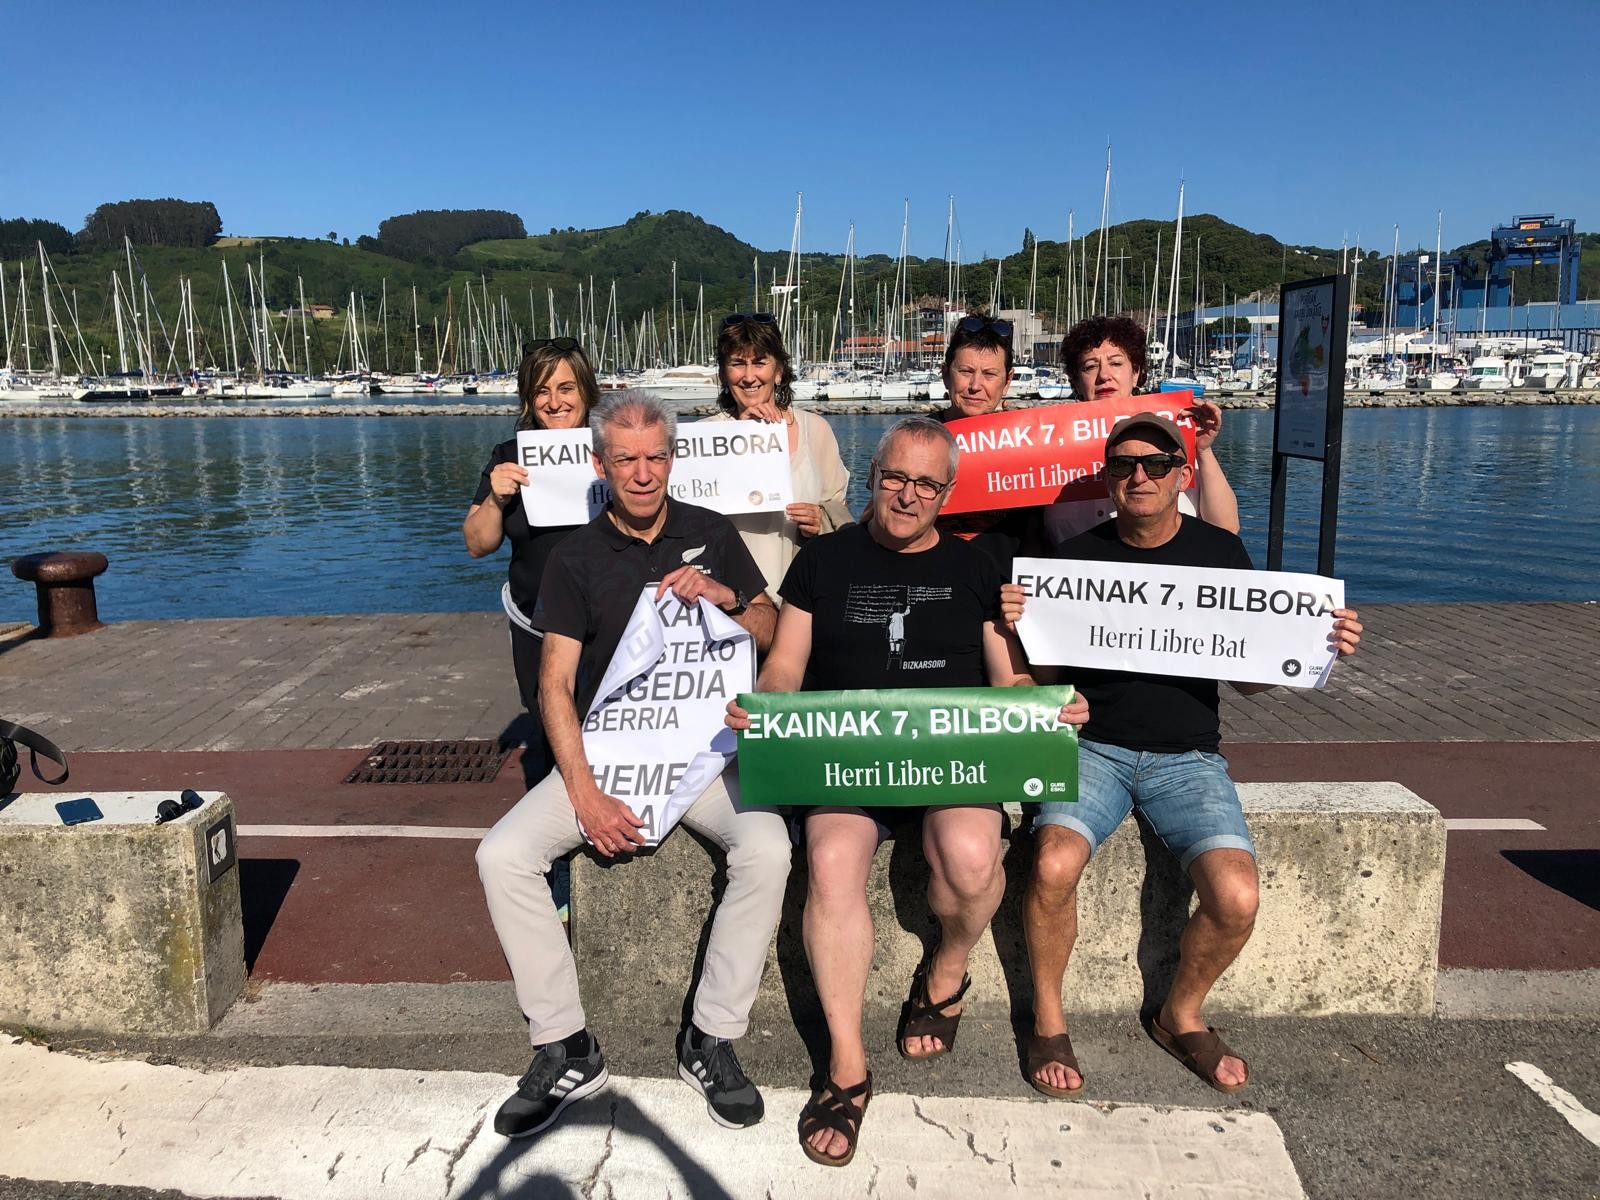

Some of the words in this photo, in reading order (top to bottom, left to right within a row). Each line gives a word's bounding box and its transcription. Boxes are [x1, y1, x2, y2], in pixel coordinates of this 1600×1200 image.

[521, 443, 593, 467] EKAIN
[676, 432, 783, 459] BILBORA
[956, 425, 1035, 454] AINAK
[1040, 424, 1065, 447] 7,
[691, 478, 721, 498] Bat
[987, 465, 1035, 493] Herri
[1040, 462, 1088, 488] Libre
[1016, 574, 1149, 605] EKAINAK
[1159, 583, 1184, 611] 7,
[1196, 584, 1337, 618] BILBORA
[1089, 624, 1144, 650] Herri
[1150, 628, 1205, 656] Libre
[1211, 633, 1248, 659] Bat
[583, 705, 680, 733] BERRIA
[742, 709, 883, 740] EKAINAK
[891, 711, 919, 740] 7,
[929, 706, 1074, 736] BILBORA
[589, 762, 689, 796] HEME
[824, 761, 881, 787] Herri
[887, 760, 944, 787] Libre
[950, 760, 988, 785] Bat
